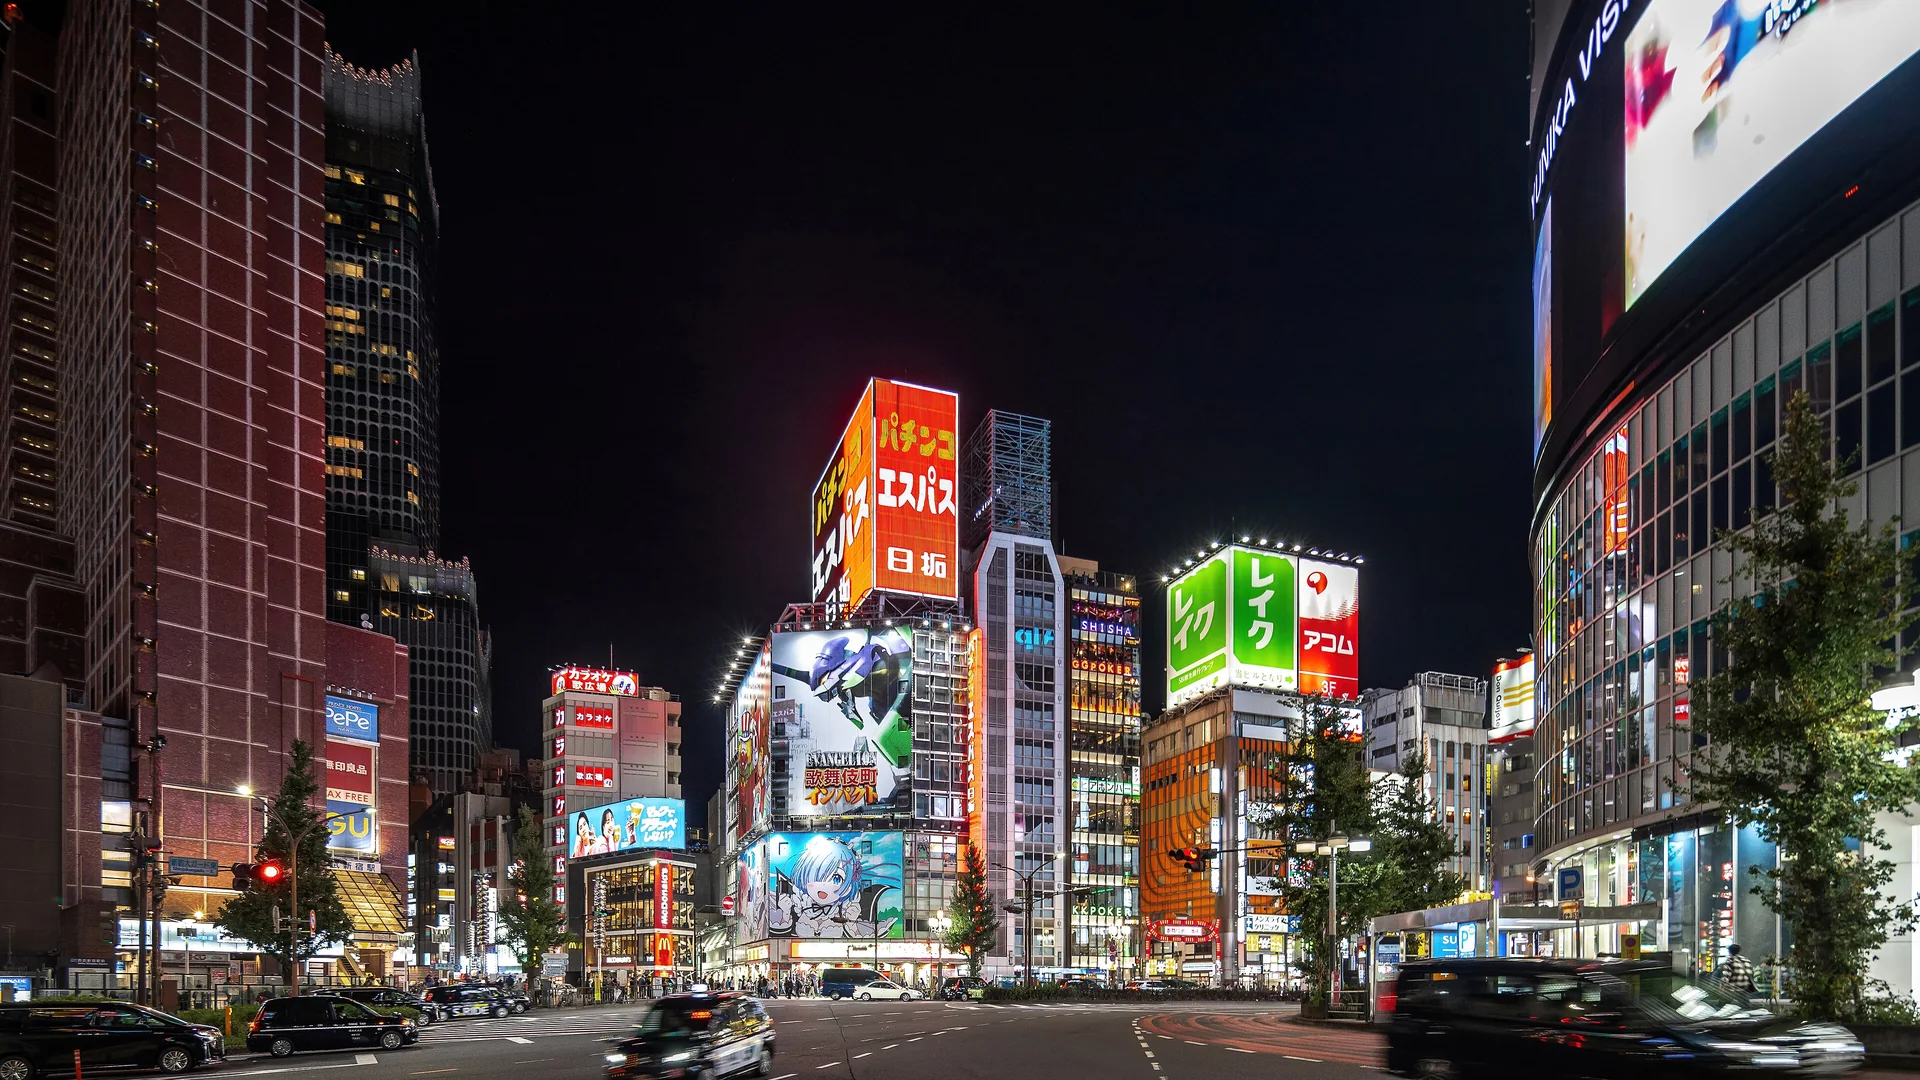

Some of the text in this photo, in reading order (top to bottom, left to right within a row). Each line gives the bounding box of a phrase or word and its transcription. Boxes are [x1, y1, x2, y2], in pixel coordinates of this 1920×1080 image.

[1578, 0, 1629, 81] VIS
[880, 411, 954, 460] パチンコ
[816, 426, 862, 536] パチンコ
[878, 465, 955, 516] エスパス
[813, 476, 870, 597] エスパス
[887, 546, 946, 579] 日拓
[1248, 557, 1275, 650] レイク
[1081, 620, 1132, 636] SHISHA
[1173, 588, 1215, 651] レイク
[1303, 630, 1354, 655] アコム
[569, 669, 613, 683] カラオケ
[1072, 659, 1131, 675] GGPOKER
[572, 681, 607, 692] 歌広場
[1321, 679, 1338, 695] 3F
[576, 712, 613, 723] カラオケ
[773, 707, 795, 717] エスパス
[805, 750, 877, 767] EVANGELION
[576, 771, 603, 781] 歌広場
[805, 768, 878, 787] 歌舞伎町
[327, 790, 369, 803] AX FREE
[804, 785, 879, 805] インパクト
[326, 811, 369, 838] GU
[1561, 869, 1580, 898] P
[660, 867, 669, 925] McDonald's
[1072, 905, 1131, 917] KKPOKER
